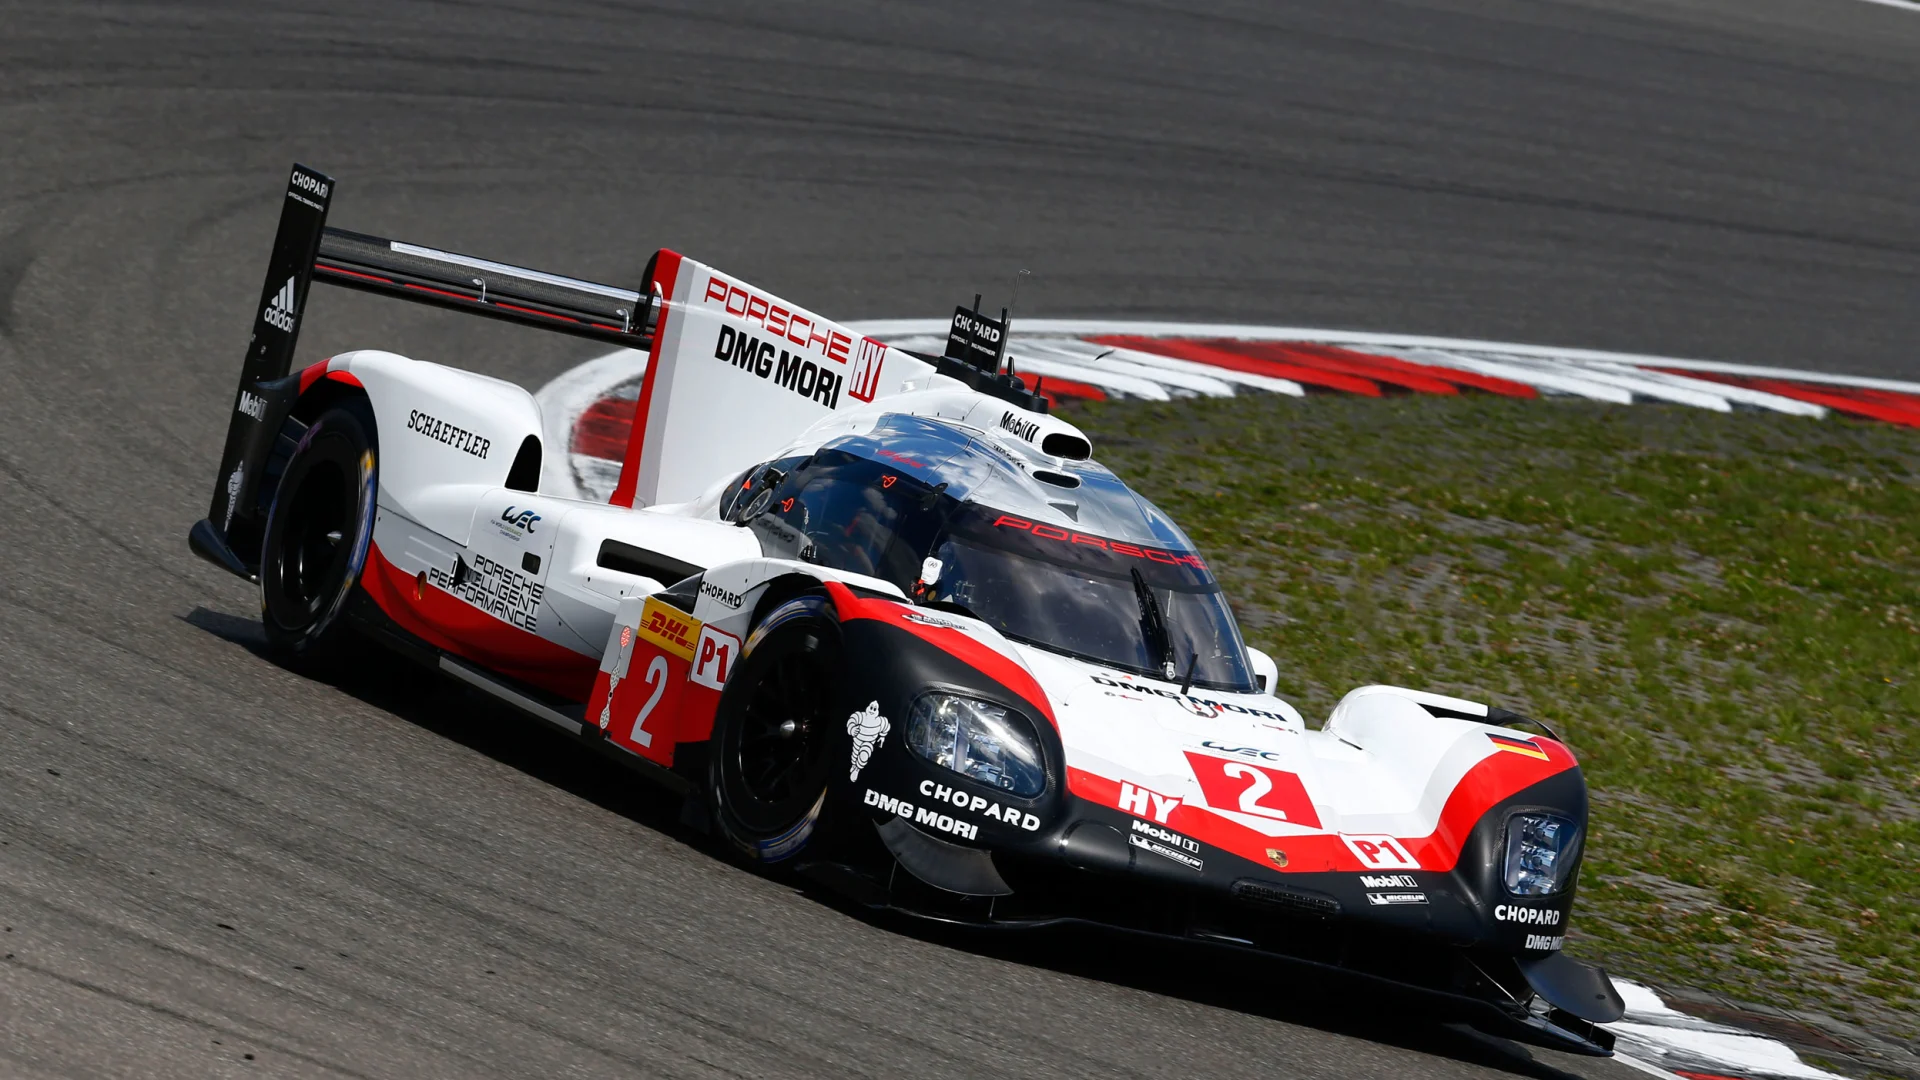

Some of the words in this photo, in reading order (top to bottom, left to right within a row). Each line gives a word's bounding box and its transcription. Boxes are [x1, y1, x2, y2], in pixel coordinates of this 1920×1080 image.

[264, 307, 295, 333] adidas
[704, 277, 852, 364] PORSCHE
[714, 324, 775, 379] DMG
[774, 349, 843, 410] MORI
[850, 338, 887, 399] HY
[407, 409, 491, 460] SCHAEFFLER
[1000, 411, 1030, 439] Mobil
[501, 506, 542, 534] WEC
[993, 515, 1208, 571] PORSCHE
[474, 554, 544, 599] PORSCHE
[700, 581, 742, 608] CHOPARD
[647, 611, 690, 648] DHL
[697, 636, 729, 683] P1
[630, 655, 668, 748] 2
[1089, 675, 1181, 701] DMG
[1186, 695, 1288, 722] MORI
[1202, 741, 1280, 761] WEC
[919, 780, 1041, 831] CHOPARD
[1118, 781, 1180, 824] HY
[1223, 762, 1287, 820] 2
[864, 789, 914, 819] DMG
[915, 808, 979, 841] MORI
[1132, 820, 1181, 846] Mobil
[1151, 844, 1201, 866] MICHELIN
[1352, 840, 1408, 863] P1
[1360, 875, 1405, 888] Mobil
[1494, 904, 1560, 926] CHOPARD
[1525, 933, 1551, 950] DMG
